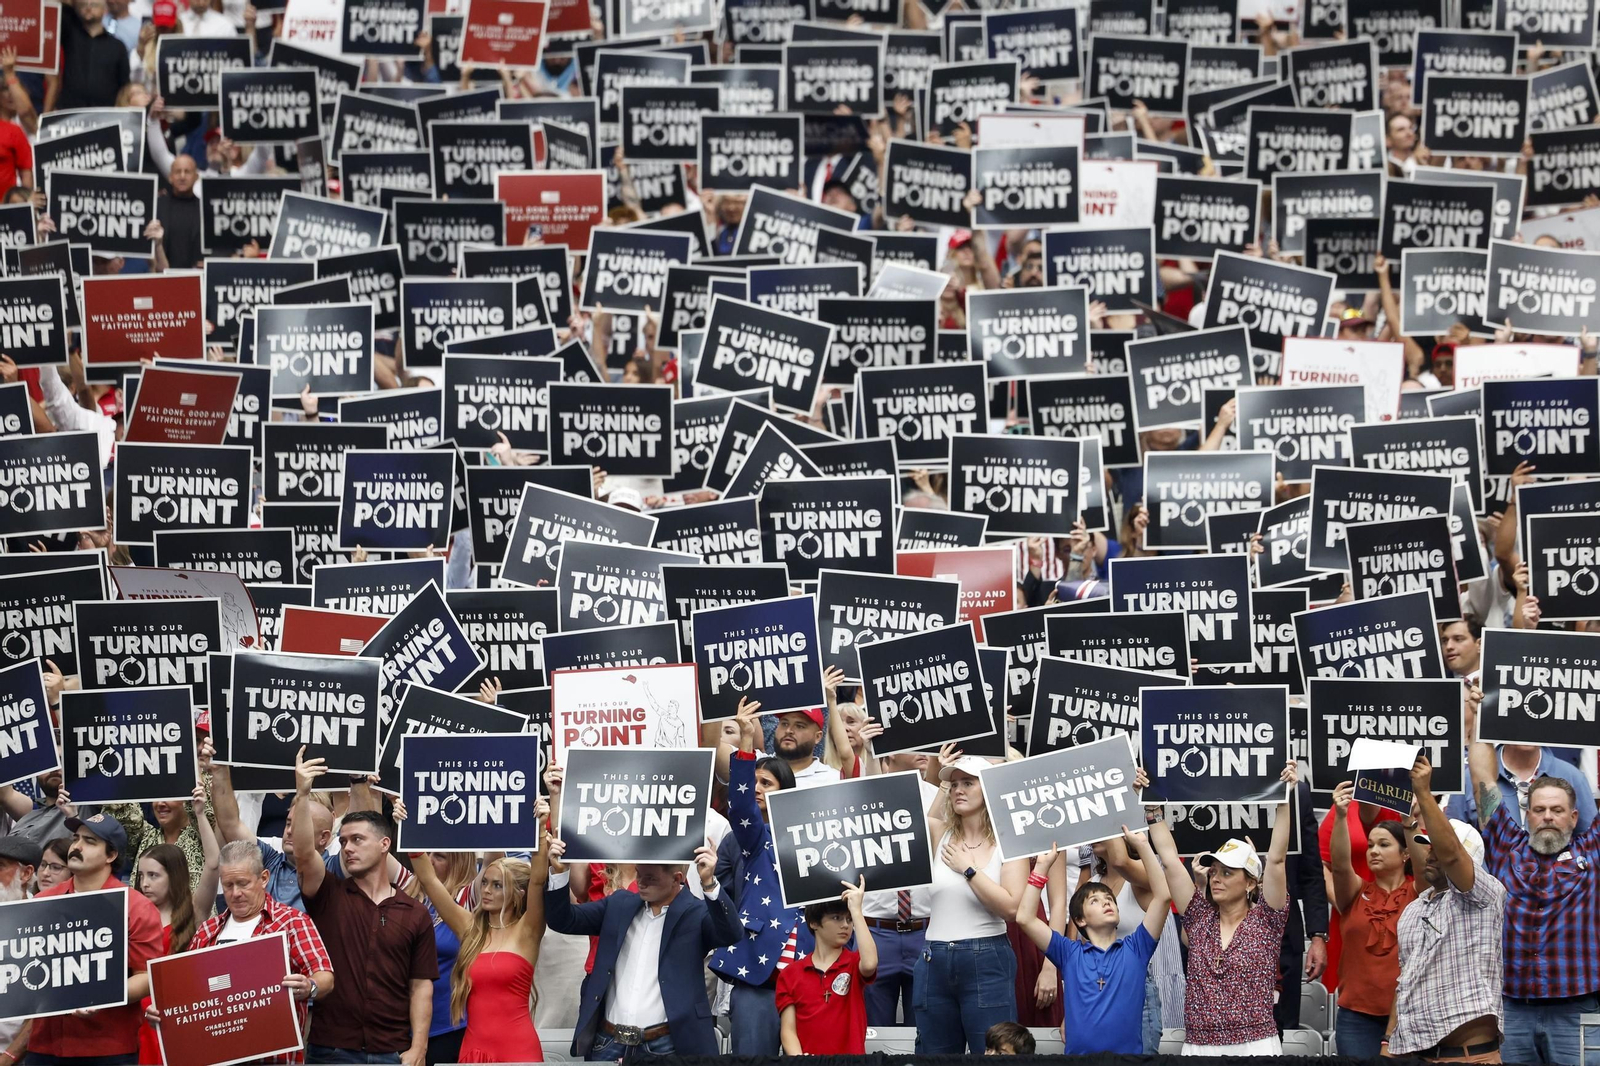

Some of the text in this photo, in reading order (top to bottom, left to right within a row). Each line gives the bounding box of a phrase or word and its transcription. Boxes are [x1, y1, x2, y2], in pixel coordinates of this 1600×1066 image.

[792, 65, 874, 82] TURNING
[1097, 57, 1179, 77] TURNING
[794, 80, 874, 102] POINT
[1099, 74, 1179, 99] POINT
[228, 91, 310, 108] TURNING
[1433, 99, 1520, 117] TURNING
[232, 106, 310, 129] POINT
[1435, 115, 1519, 139] POINT
[708, 138, 794, 155] TURNING
[1256, 132, 1343, 150] TURNING
[440, 146, 525, 162] TURNING
[710, 152, 794, 177] POINT
[1257, 149, 1343, 171] POINT
[982, 169, 1072, 188] TURNING
[58, 196, 145, 216] TURNING
[984, 186, 1072, 211] POINT
[1162, 201, 1249, 221] TURNING
[1392, 205, 1484, 226] TURNING
[60, 212, 145, 239] POINT
[1162, 219, 1249, 245] POINT
[1392, 223, 1482, 247] POINT
[1053, 252, 1144, 272] TURNING
[1498, 269, 1596, 294] TURNING
[1220, 280, 1318, 316] TURNING
[1498, 286, 1595, 317] POINT
[92, 314, 114, 323] WELL
[148, 312, 177, 320] GOOD
[102, 320, 186, 330] FAITHFUL SERVANT
[412, 306, 504, 325] TURNING
[978, 314, 1078, 336] TURNING
[1217, 300, 1315, 337] POINT
[266, 332, 363, 352] TURNING
[718, 326, 815, 366] TURNING
[983, 333, 1078, 360] POINT
[270, 352, 363, 377] POINT
[713, 345, 811, 391] POINT
[1141, 354, 1241, 386] TURNING
[872, 393, 976, 416] TURNING
[559, 412, 661, 432] TURNING
[878, 413, 977, 441] POINT
[1249, 414, 1355, 436] TURNING
[1492, 408, 1589, 428] TURNING
[563, 432, 661, 457] POINT
[1496, 428, 1590, 455] POINT
[128, 475, 239, 496] TURNING
[961, 465, 1069, 486] TURNING
[353, 482, 444, 500] TURNING
[964, 485, 1068, 514] POINT
[131, 495, 238, 524] POINT
[353, 500, 443, 528] POINT
[770, 509, 882, 531] TURNING
[776, 530, 882, 559] POINT
[1358, 549, 1444, 575] TURNING
[724, 631, 745, 639] THIS
[765, 624, 784, 633] OUR
[1330, 630, 1353, 638] THIS
[1375, 621, 1397, 630] OUR
[89, 633, 208, 655] TURNING
[704, 631, 807, 664] TURNING
[1309, 627, 1423, 664] TURNING
[96, 655, 207, 686] POINT
[709, 655, 808, 695] POINT
[890, 662, 910, 672] THIS
[928, 654, 946, 663] OUR
[271, 678, 295, 686] THIS
[872, 660, 969, 698] TURNING
[245, 687, 365, 713] TURNING
[879, 682, 973, 729] POINT
[248, 711, 365, 747] POINT
[561, 708, 646, 726] TURNING
[1323, 715, 1449, 736] TURNING
[73, 722, 181, 747] TURNING
[564, 724, 646, 748] POINT
[1153, 723, 1274, 744] TURNING
[78, 746, 182, 778] POINT
[1157, 746, 1274, 778] POINT
[414, 770, 525, 792] TURNING
[1023, 777, 1048, 786] THIS
[1072, 764, 1095, 775] OUR
[577, 782, 696, 805] TURNING
[1000, 767, 1125, 809] TURNING
[1358, 777, 1412, 803] CHARLIE
[417, 792, 525, 824] POINT
[811, 810, 835, 818] THIS
[862, 802, 884, 811] OUR
[1010, 786, 1129, 835] POINT
[577, 805, 694, 837] POINT
[787, 809, 912, 846] TURNING
[795, 832, 915, 878] POINT
[18, 926, 43, 934] THIS
[67, 919, 89, 928] OUR
[0, 927, 113, 960] TURNING
[0, 951, 113, 994] POINT
[164, 984, 282, 1017] WELL DONE, GOOD AND
[176, 997, 272, 1025] FAITHFUL SERVANT
[205, 1021, 231, 1032] CHARLIE
